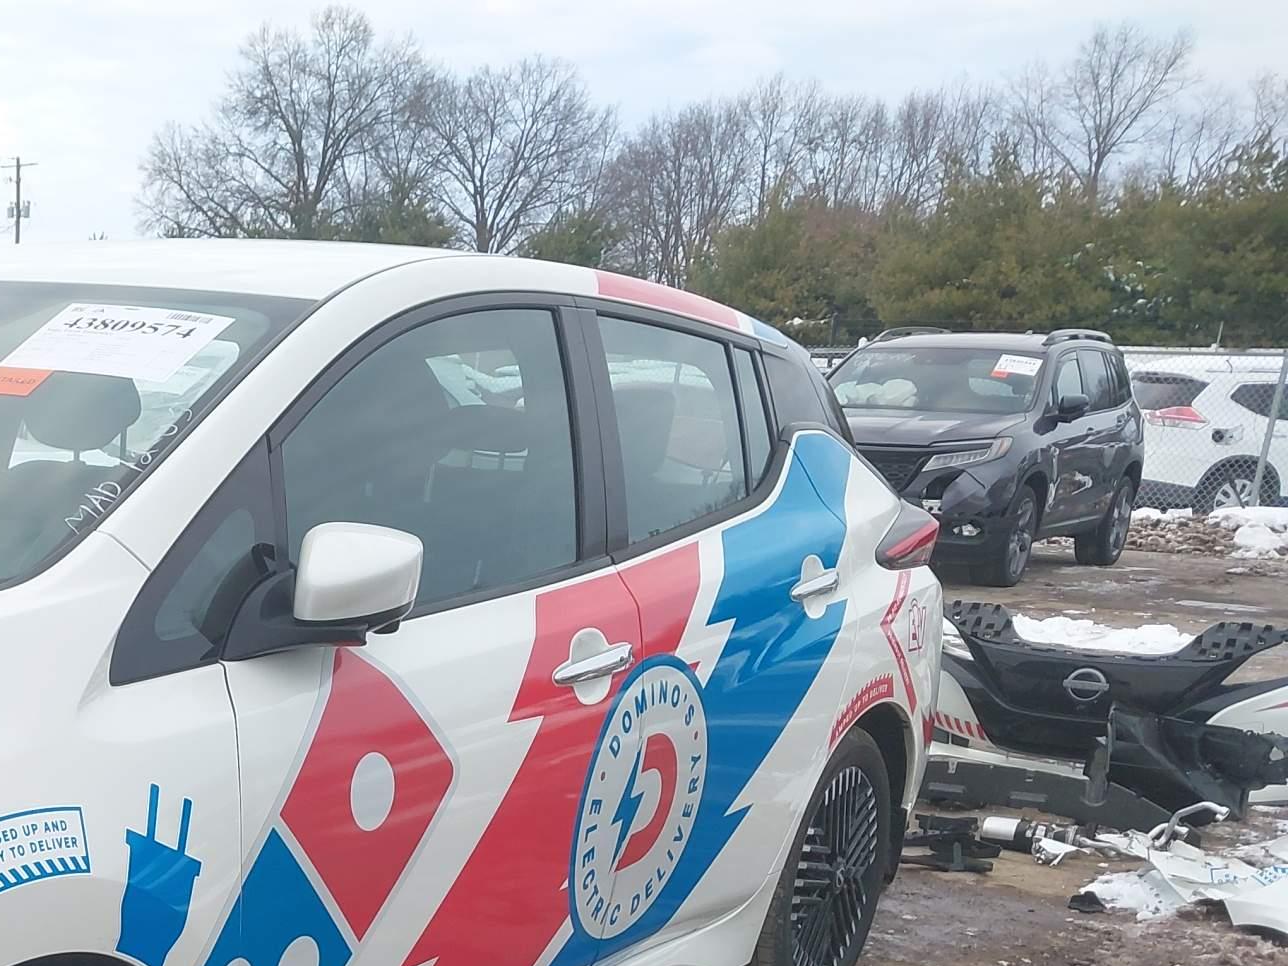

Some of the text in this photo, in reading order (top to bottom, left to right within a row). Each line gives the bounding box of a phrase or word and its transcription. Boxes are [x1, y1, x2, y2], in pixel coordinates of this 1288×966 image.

[64, 316, 197, 339] 43809574
[65, 481, 121, 535] MAD
[609, 679, 695, 758] DOMINO'S
[9, 844, 25, 859] TO
[29, 836, 78, 854] DELIVER
[22, 823, 38, 837] UP
[44, 820, 67, 833] AND
[582, 753, 702, 926] ELECTRIC DELIVERY
